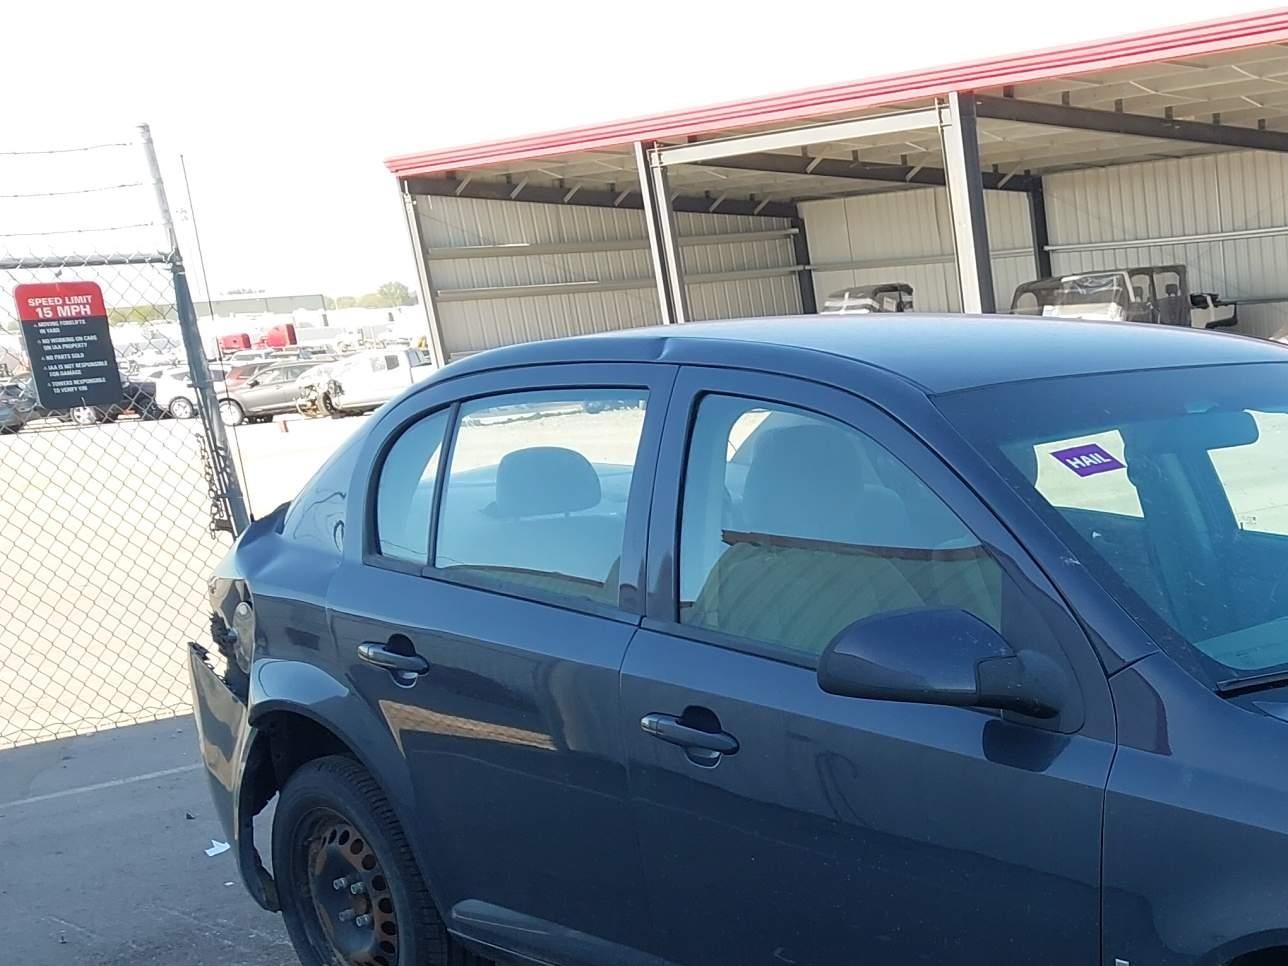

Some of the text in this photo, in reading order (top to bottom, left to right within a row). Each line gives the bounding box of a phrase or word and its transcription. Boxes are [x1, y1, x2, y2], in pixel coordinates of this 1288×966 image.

[28, 295, 93, 306] SPEED LIMIT
[36, 304, 91, 318] 15 MPH
[1065, 452, 1112, 469] HAIL
